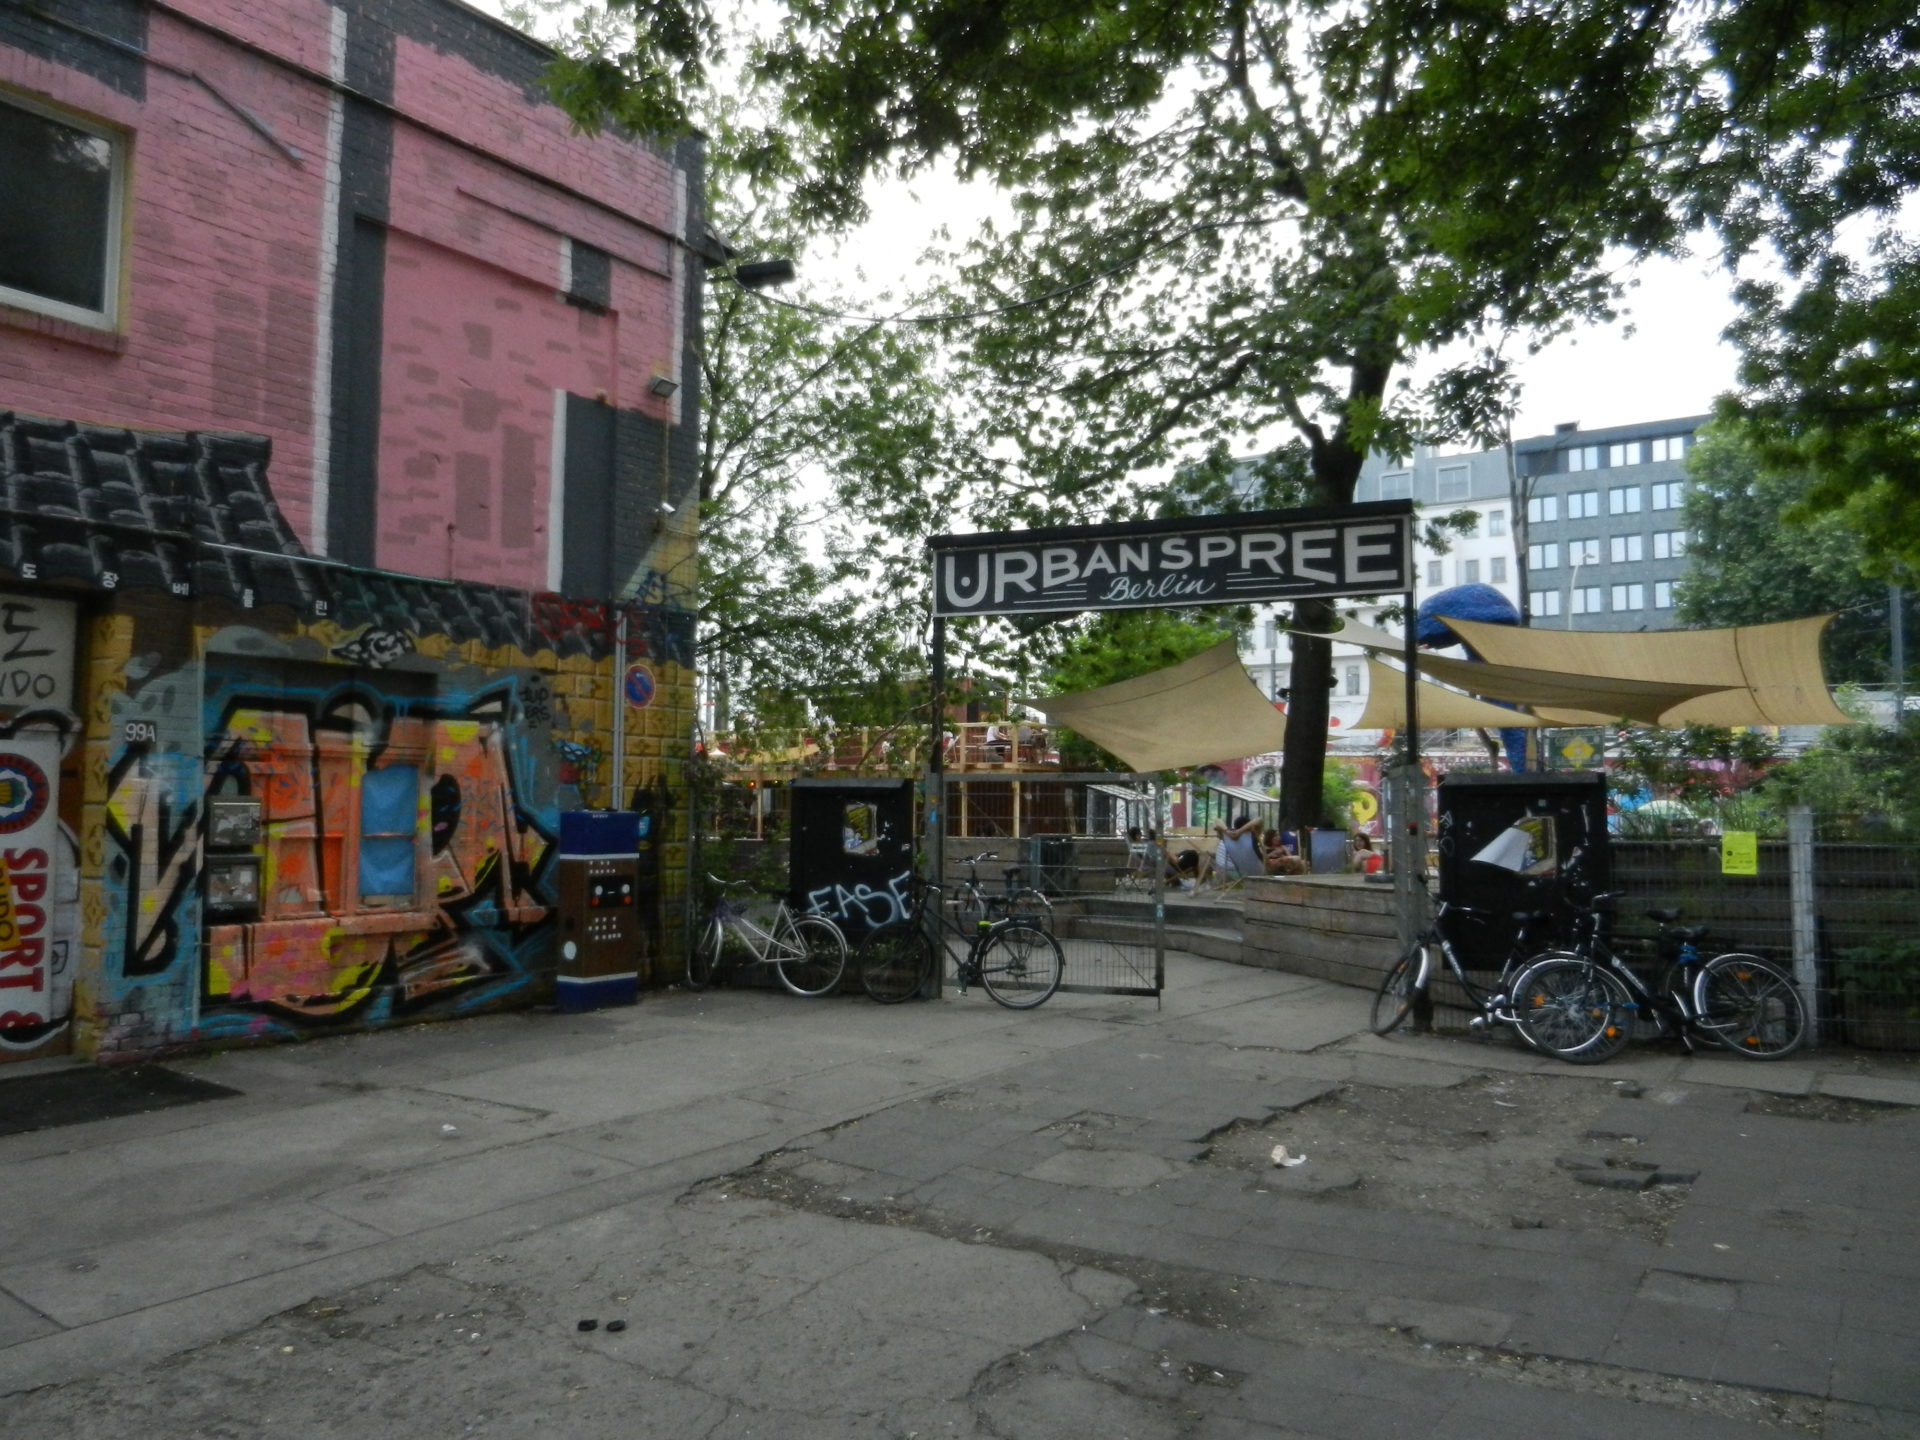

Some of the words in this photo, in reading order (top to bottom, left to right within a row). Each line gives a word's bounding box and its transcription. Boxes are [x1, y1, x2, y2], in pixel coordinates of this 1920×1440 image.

[1101, 573, 1216, 601] Berlin
[126, 722, 156, 742] 99A
[0, 848, 49, 992] SPORT
